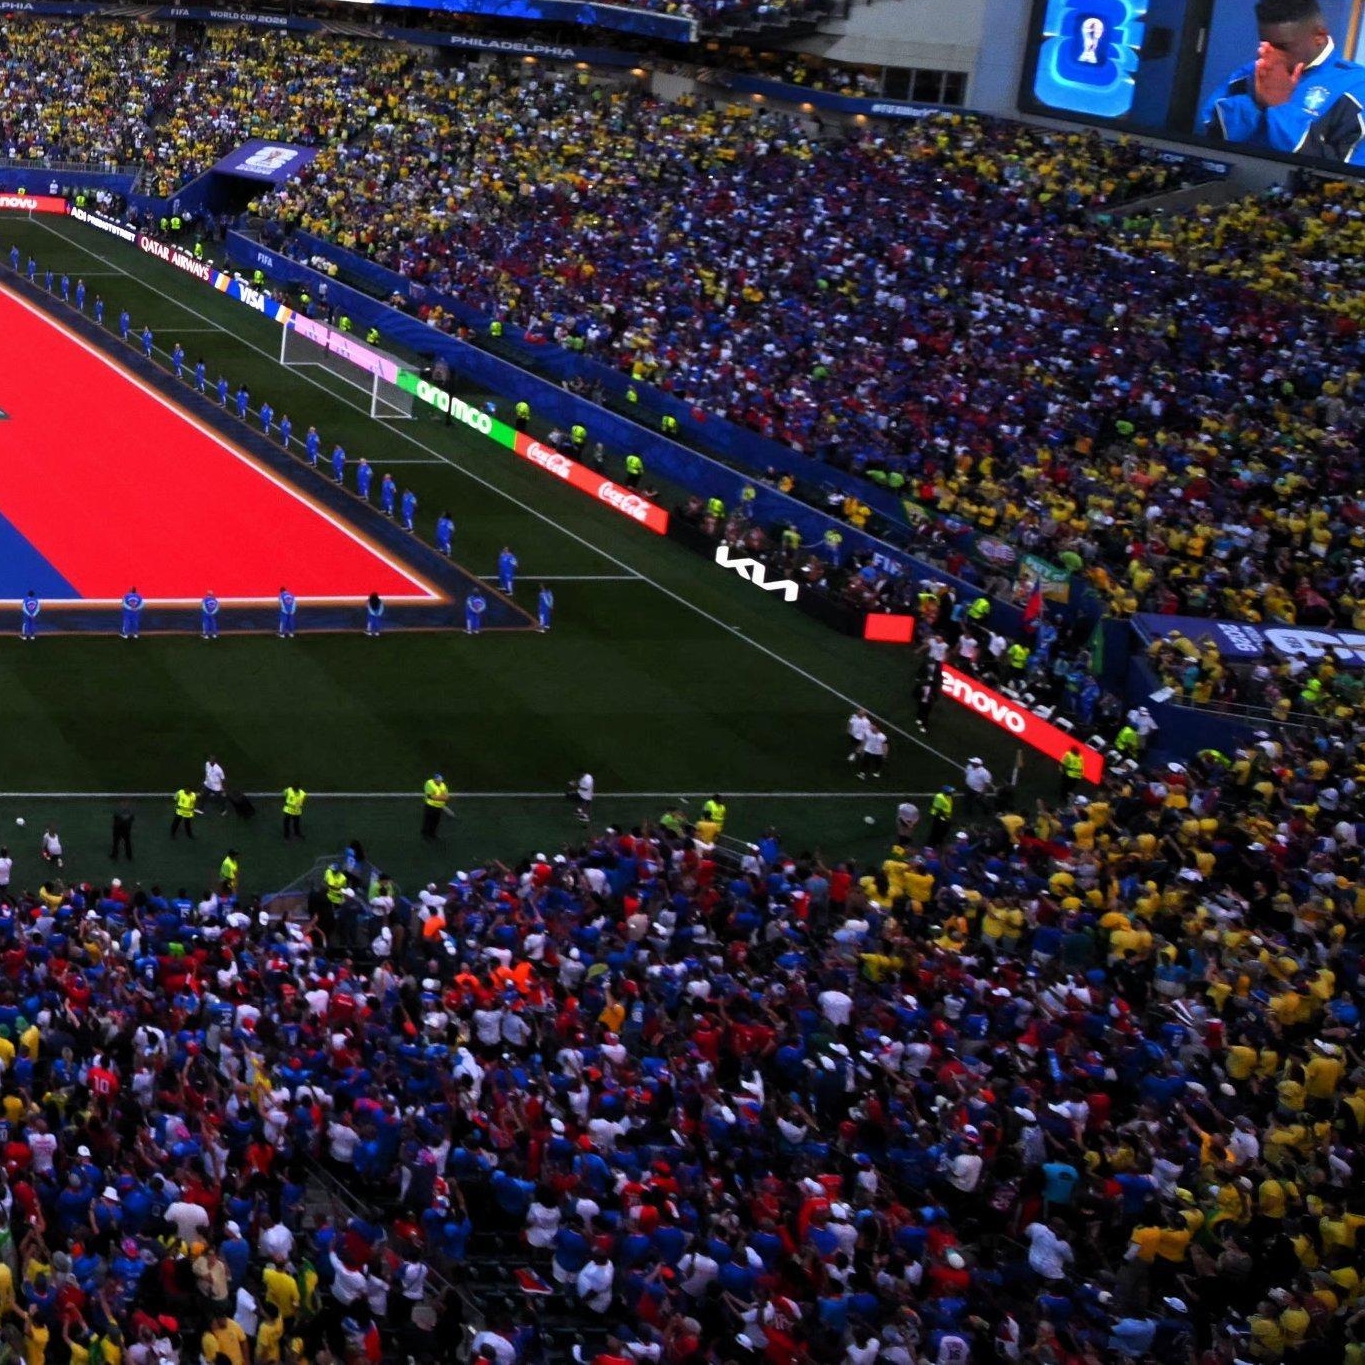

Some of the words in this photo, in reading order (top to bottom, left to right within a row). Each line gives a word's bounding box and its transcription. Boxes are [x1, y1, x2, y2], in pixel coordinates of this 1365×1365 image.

[170, 8, 190, 17] FIFA
[209, 9, 240, 20] WORLD
[240, 12, 258, 22] CUP
[450, 35, 576, 58] PHILADELPHIA
[140, 236, 170, 262] QATAR
[171, 248, 211, 282] AIRWAYS
[257, 251, 274, 269] FIFA
[239, 283, 265, 313] VISA
[416, 380, 493, 435] aramco
[597, 481, 651, 522] Coca-Cola
[941, 670, 1026, 734] enovo
[92, 1075, 108, 1094] 10
